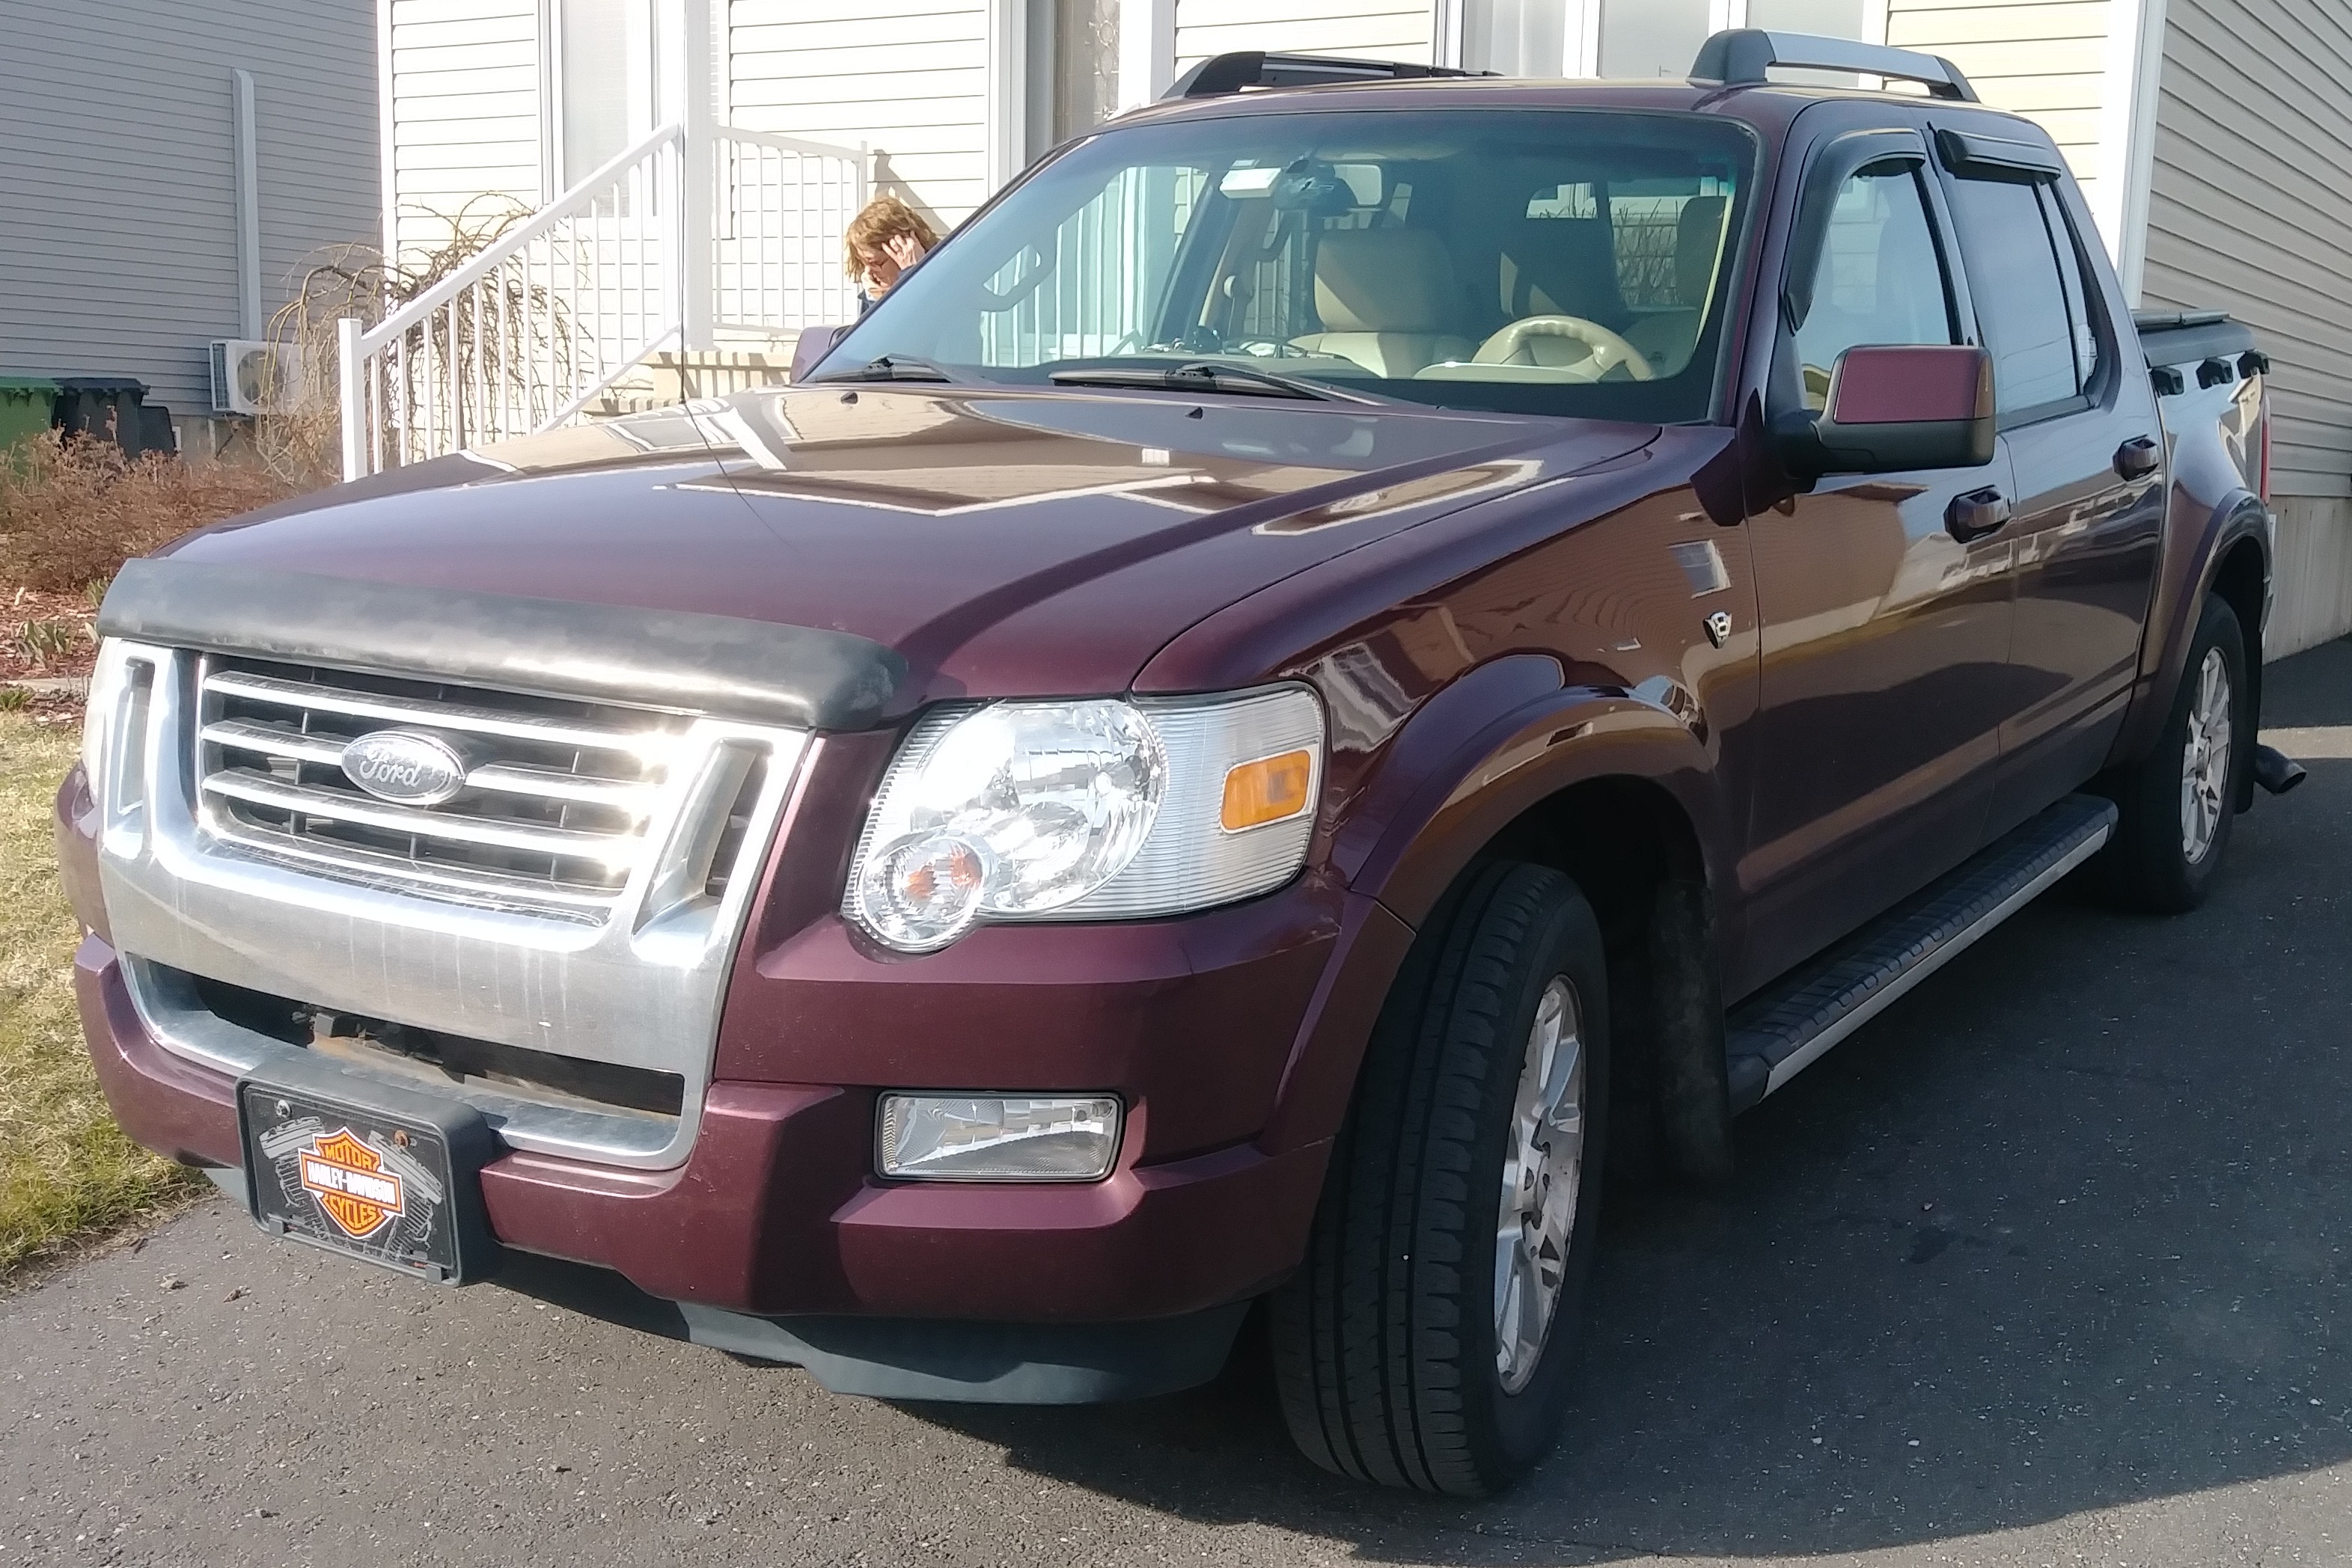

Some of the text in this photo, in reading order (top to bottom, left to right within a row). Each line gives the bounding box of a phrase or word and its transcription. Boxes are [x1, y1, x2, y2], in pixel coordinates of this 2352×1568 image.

[359, 747, 424, 787] Ford
[324, 1142, 373, 1169] MOTOR
[307, 1160, 397, 1204] HARLEY-DAVIDSON
[330, 1195, 376, 1228] CYCLES
